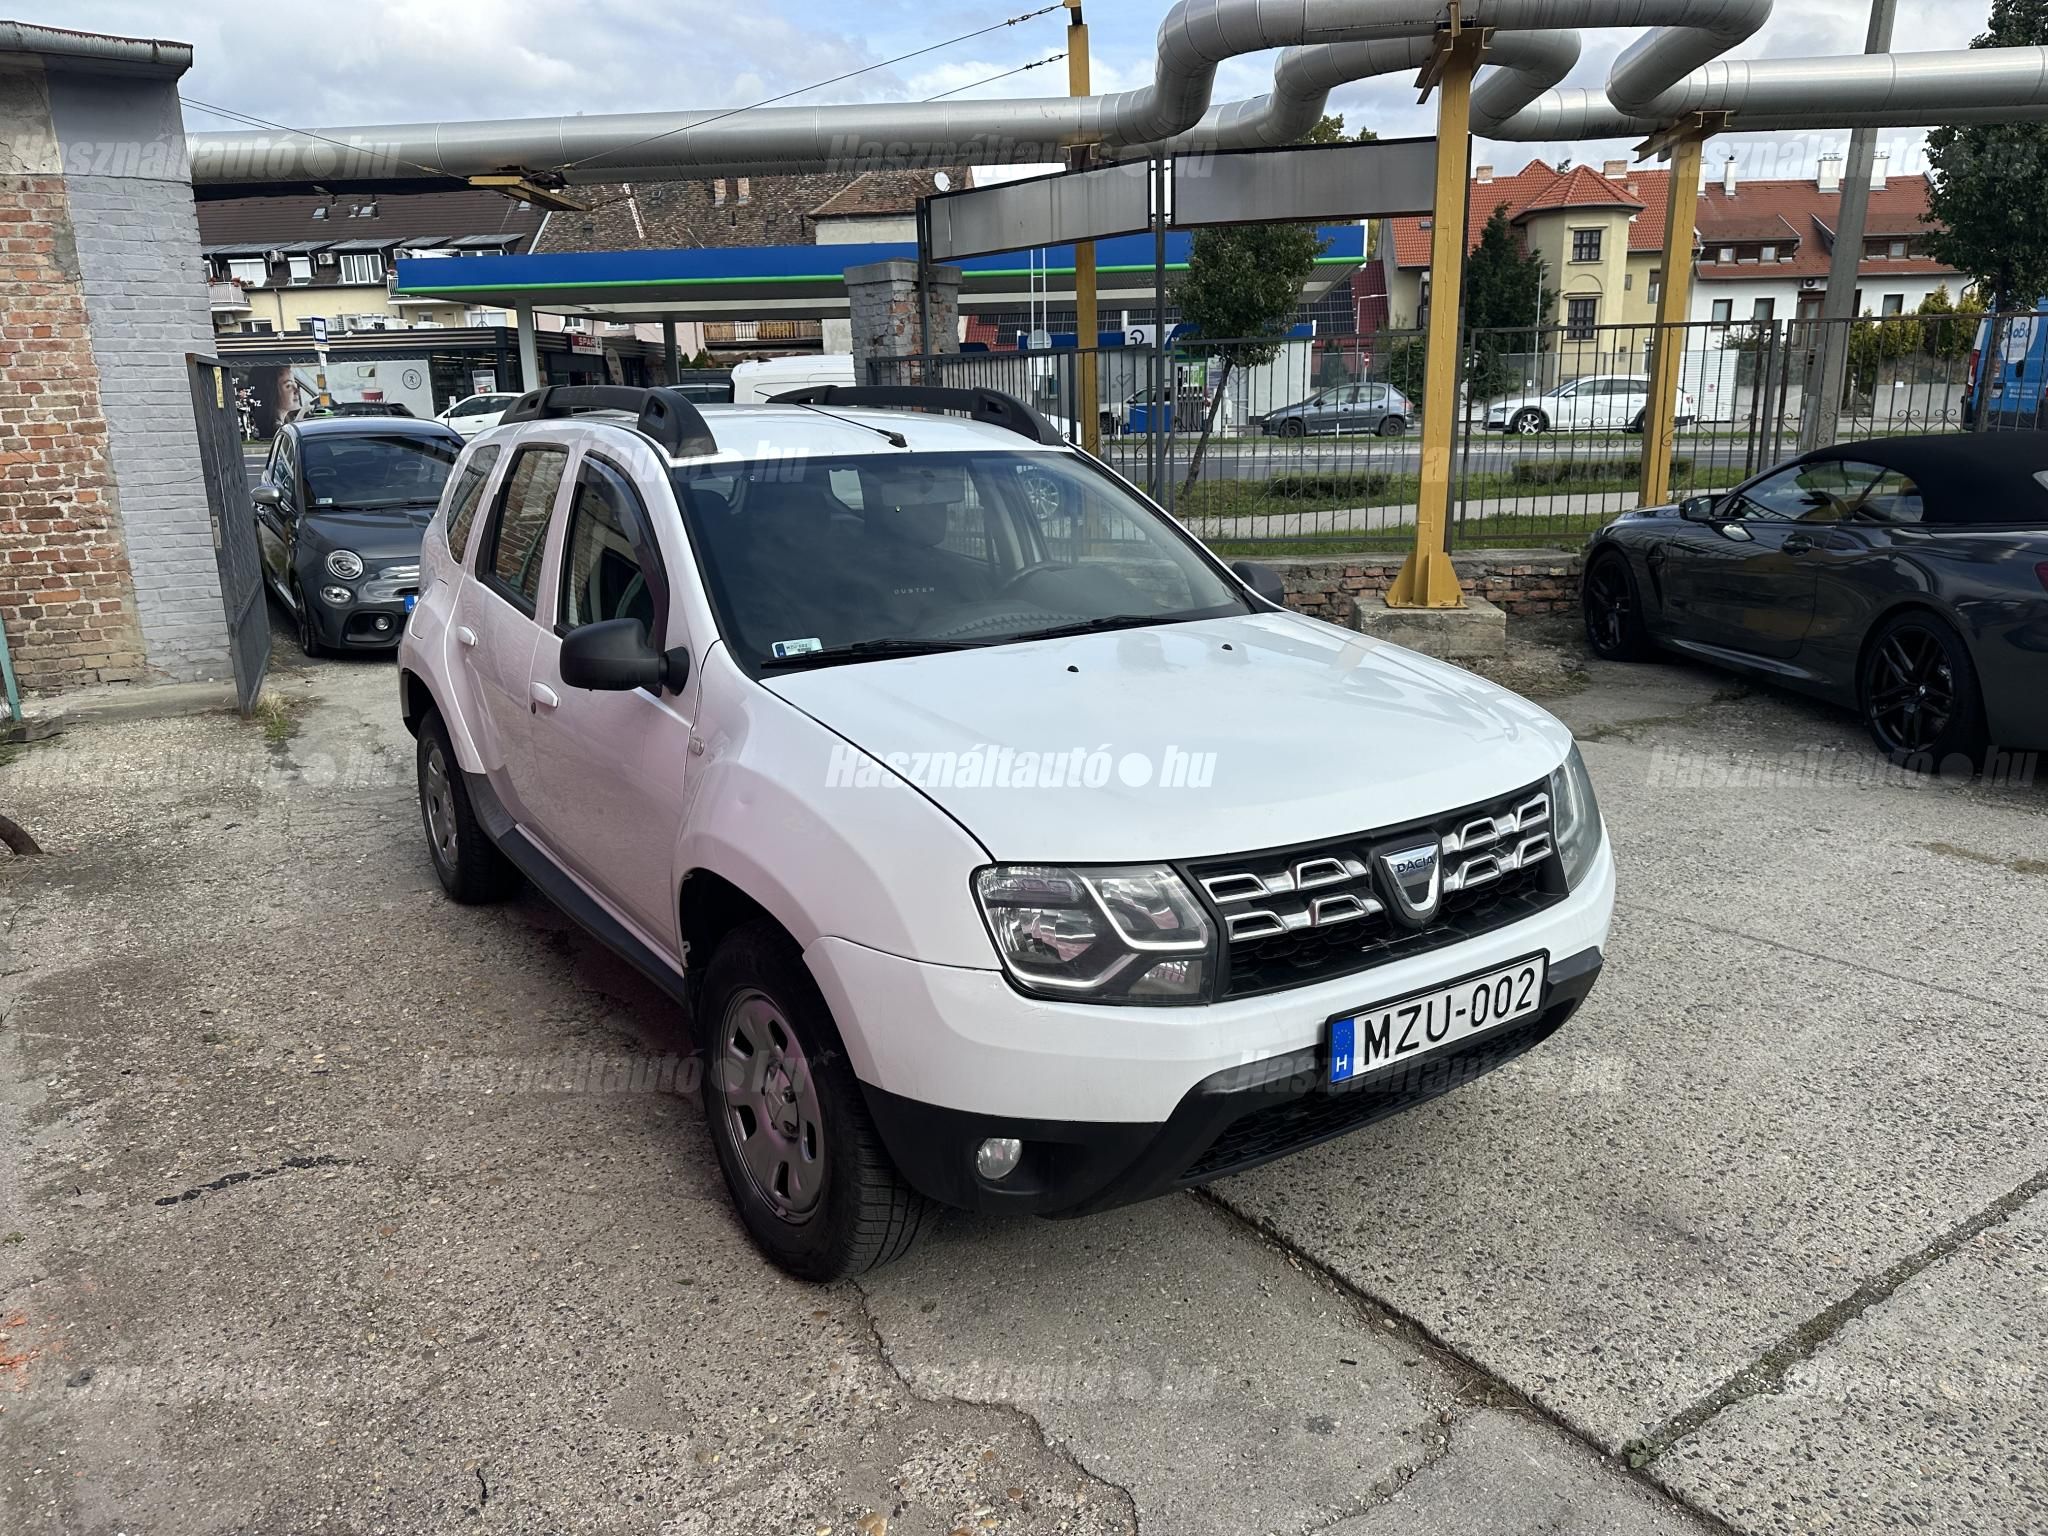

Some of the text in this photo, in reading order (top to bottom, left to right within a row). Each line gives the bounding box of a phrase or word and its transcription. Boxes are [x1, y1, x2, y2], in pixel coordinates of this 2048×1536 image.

[1396, 856, 1435, 873] DACIA
[1336, 967, 1536, 1072] H MZU-002
